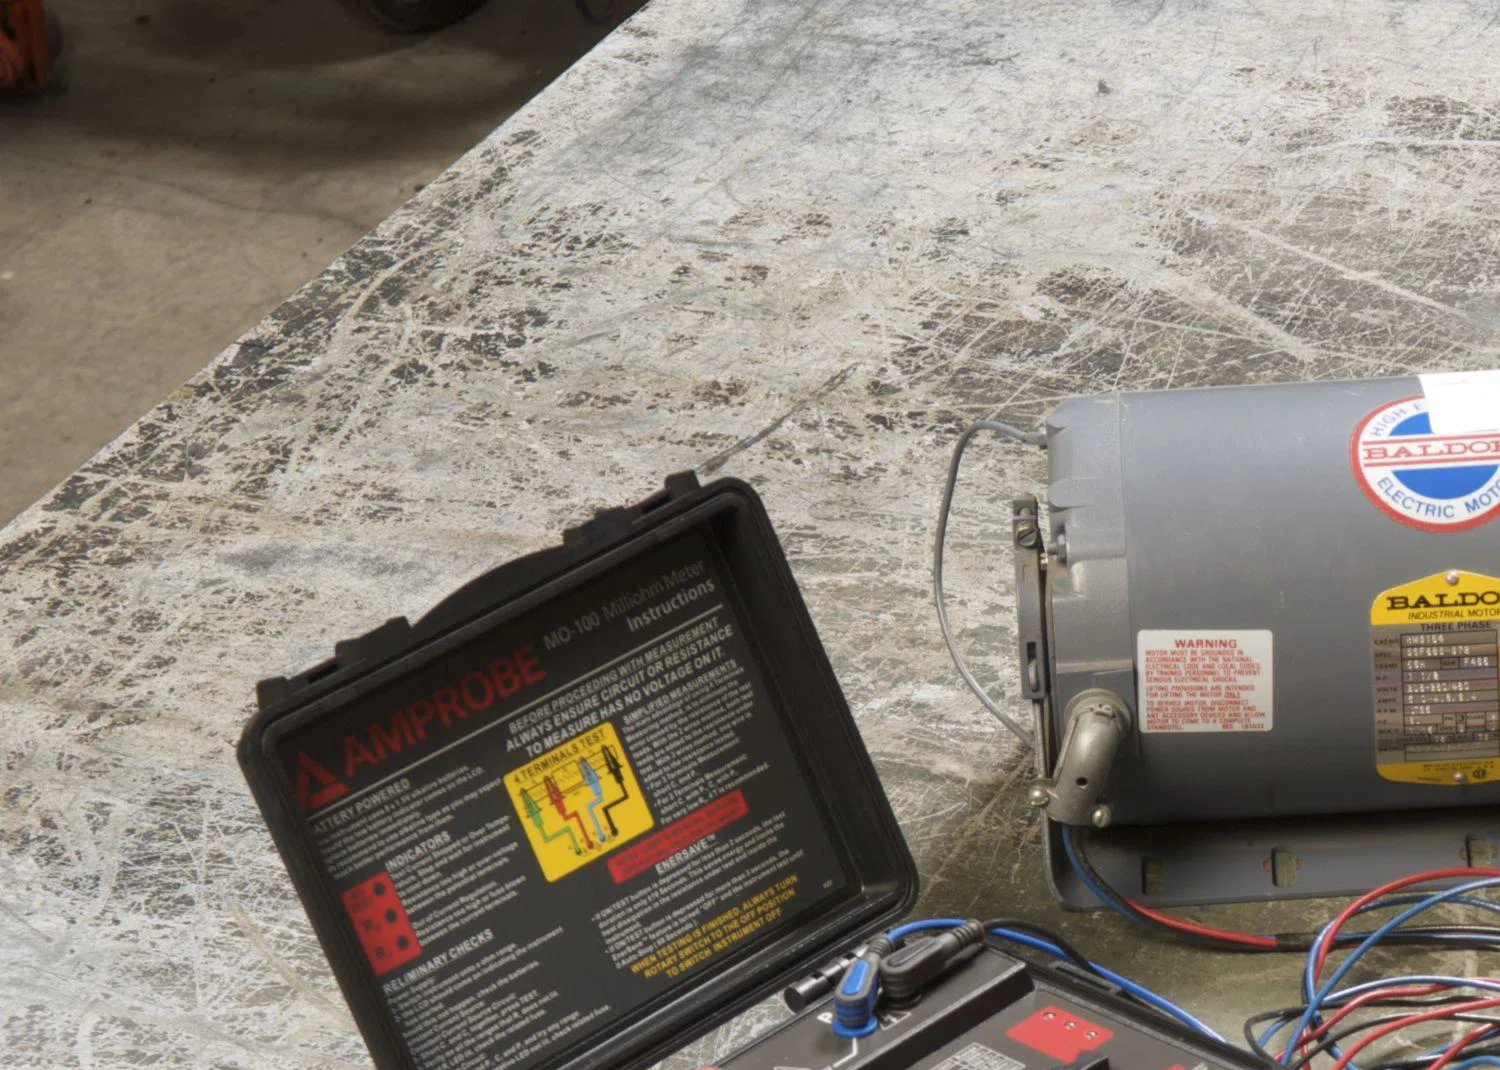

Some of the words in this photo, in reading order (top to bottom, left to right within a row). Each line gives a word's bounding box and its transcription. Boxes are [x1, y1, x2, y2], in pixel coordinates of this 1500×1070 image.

[1370, 408, 1407, 437] HIGH
[1377, 476, 1455, 518] ELECTRIC
[543, 611, 600, 650] MO-100
[601, 582, 664, 620] Milliohm
[662, 560, 704, 590] Meter
[626, 579, 714, 631] Instructions
[1408, 610, 1464, 620] INDUSTRIAL
[1421, 622, 1454, 632] THREE
[1457, 620, 1492, 629] PHASE
[509, 704, 552, 734] BEFORE
[551, 670, 618, 712] PROCEEDING
[618, 656, 644, 677] WITH
[644, 616, 717, 663] MEASUREMENT
[1175, 639, 1237, 648] WARNING
[343, 645, 547, 775] AMPROBE
[506, 719, 553, 751] ALWAYS
[553, 694, 600, 726] ENSURE
[600, 669, 644, 701] CIRCUIT
[646, 660, 664, 677] OR
[664, 624, 732, 668] RESISTANCE
[525, 741, 542, 756] TO
[543, 711, 599, 748] MEASURE
[599, 699, 623, 719] HAS
[624, 689, 641, 706] NO
[641, 661, 693, 696] VOLTAGE
[694, 652, 711, 669] ON
[711, 646, 724, 660] IT.
[623, 695, 669, 725] SIMPLIFIED
[669, 659, 736, 700] MEASUREMENTS
[315, 806, 354, 831] ATTERY
[355, 778, 409, 813] POWERED
[385, 830, 450, 870] INDICATORS
[630, 954, 657, 973] WHEN
[656, 933, 692, 958] TESTING
[691, 928, 701, 938] IS
[742, 887, 774, 911] ALWAYS
[774, 874, 797, 891] TURN
[643, 954, 677, 977] ROTARY
[678, 935, 710, 958] SWITCH
[710, 928, 723, 939] TO
[722, 919, 739, 933] THE
[739, 909, 755, 924] OFF
[756, 887, 795, 914] POSITION
[665, 966, 679, 977] TO
[678, 947, 711, 971] SWITCH
[712, 917, 764, 951] INSTRUMENT
[764, 907, 780, 922] OFF
[384, 952, 447, 992] RELIMINARY
[449, 928, 492, 958] CHECKS
